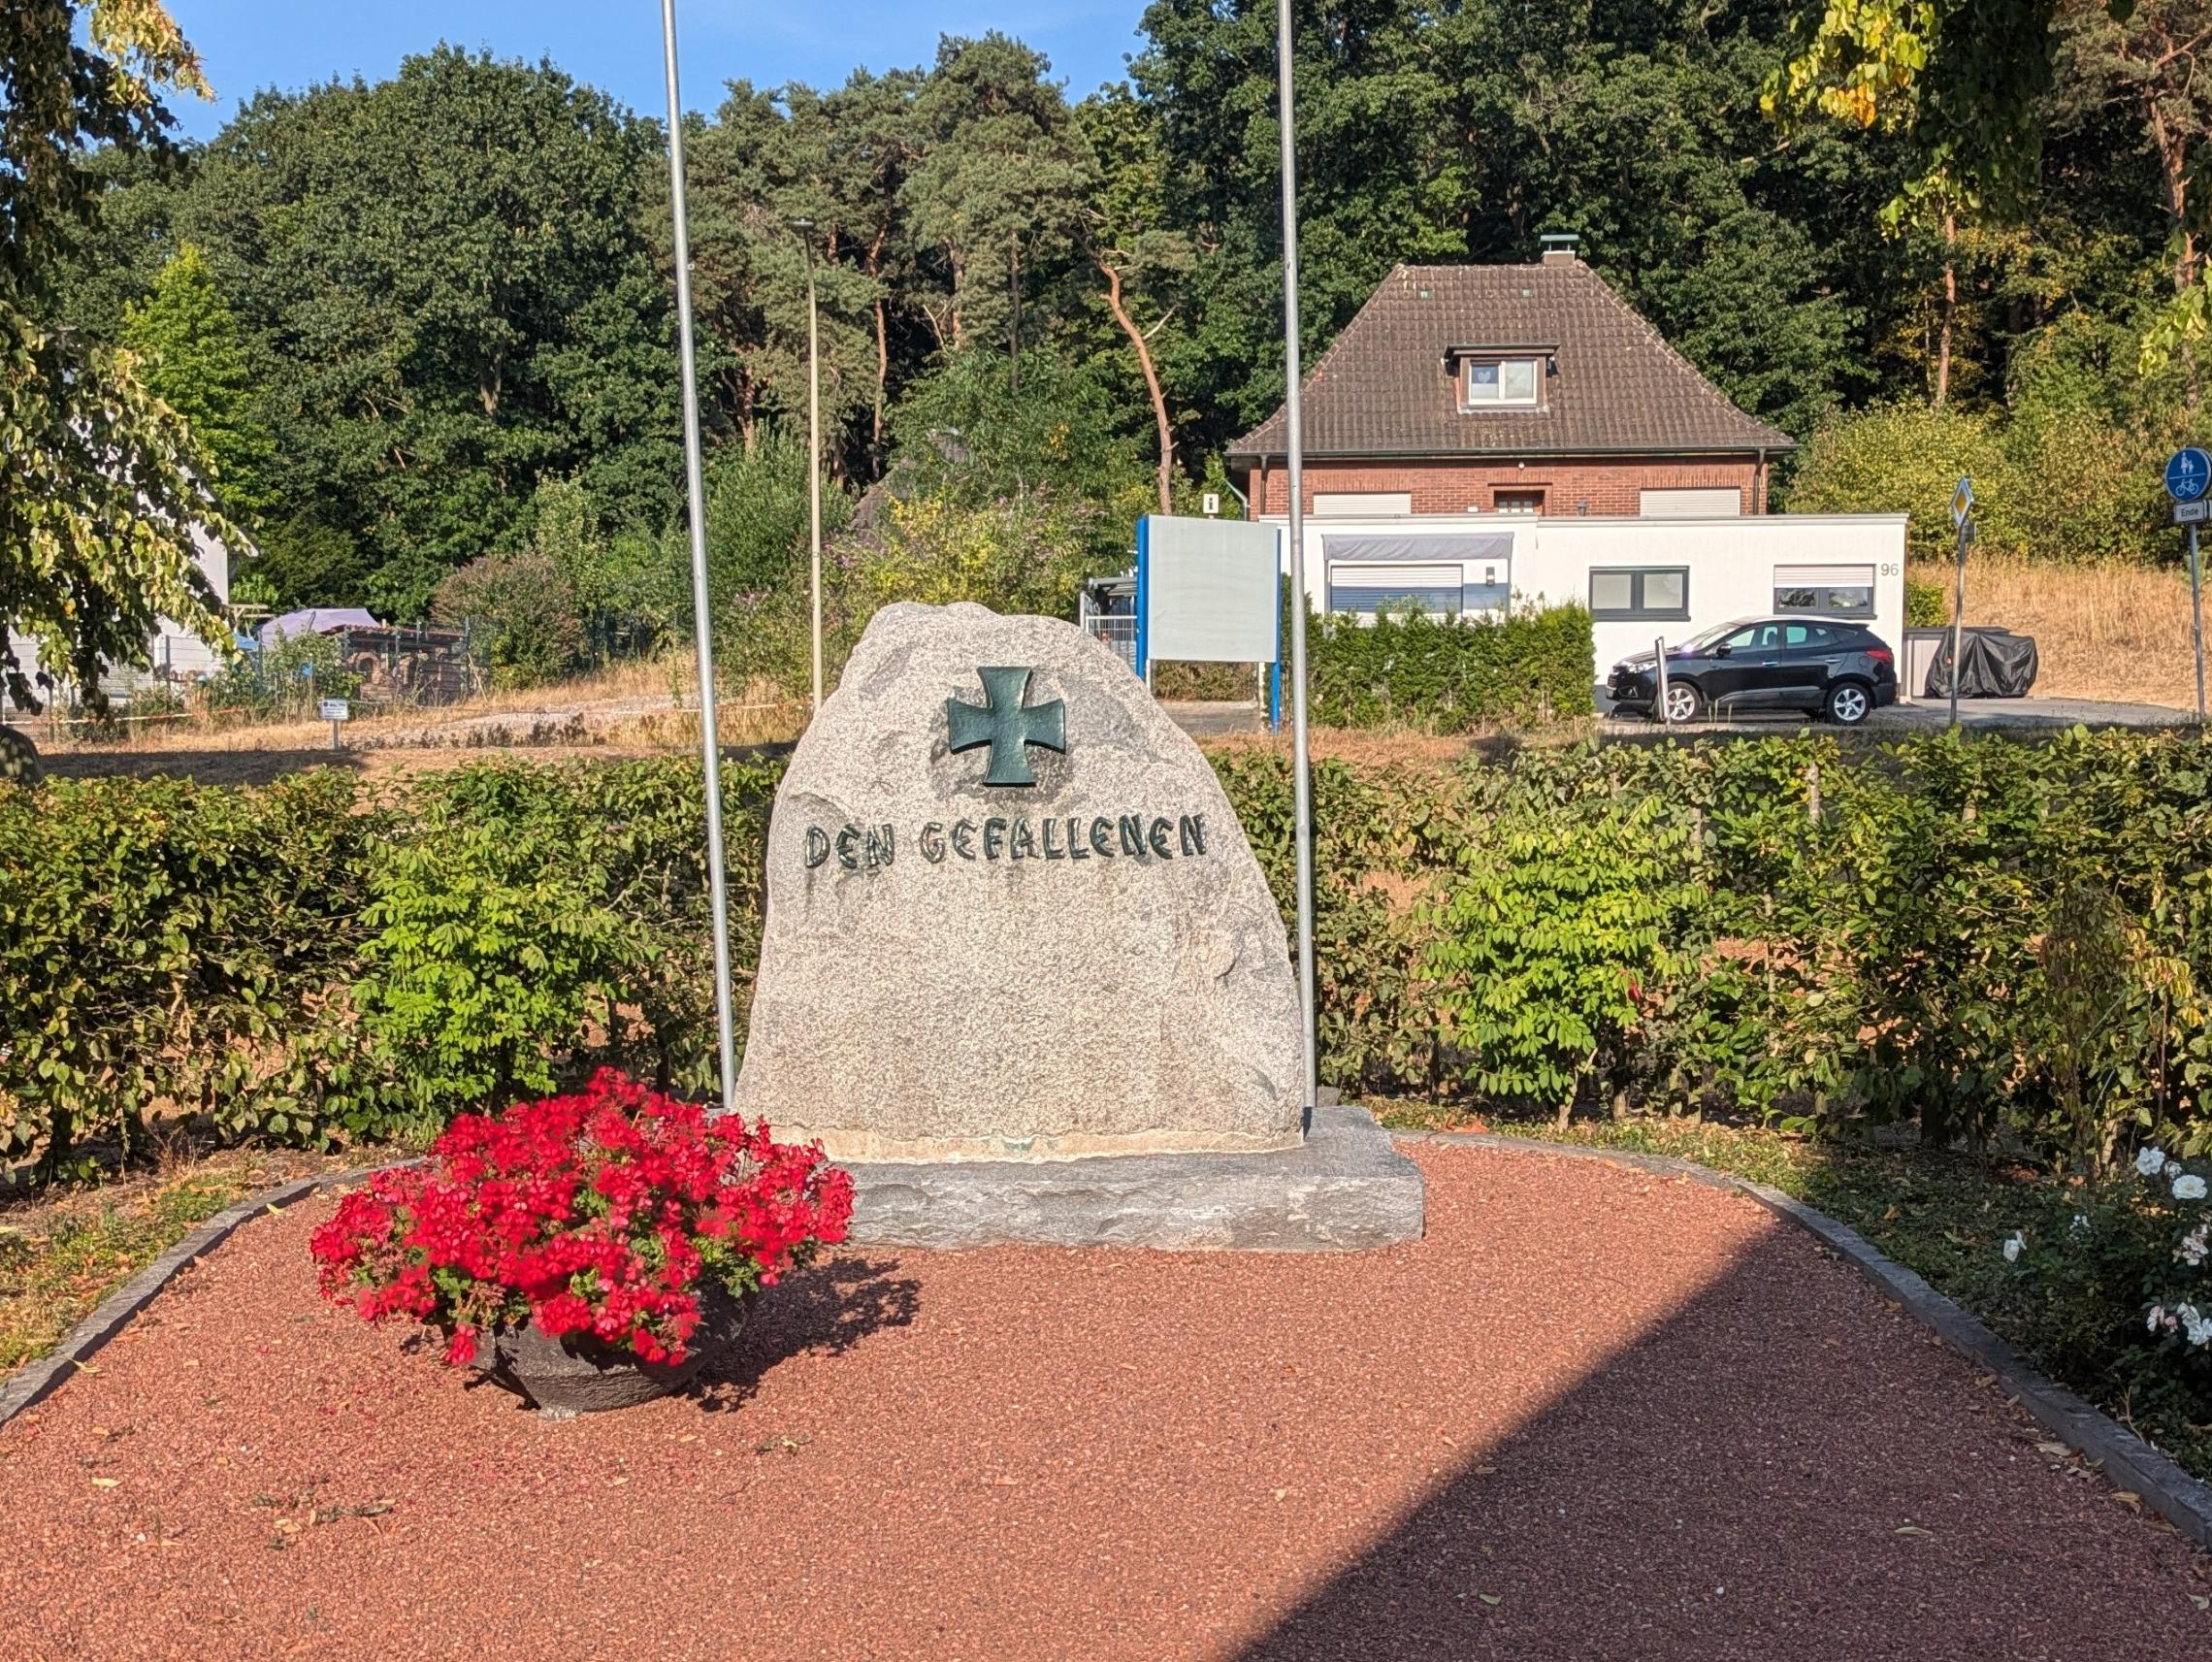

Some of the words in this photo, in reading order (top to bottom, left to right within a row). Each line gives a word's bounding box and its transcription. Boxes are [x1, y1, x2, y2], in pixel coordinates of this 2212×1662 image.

[2180, 507, 2199, 517] Ende
[1880, 563, 1900, 576] 96
[805, 823, 895, 868] DEN
[919, 813, 1208, 864] GEFALLENEN
